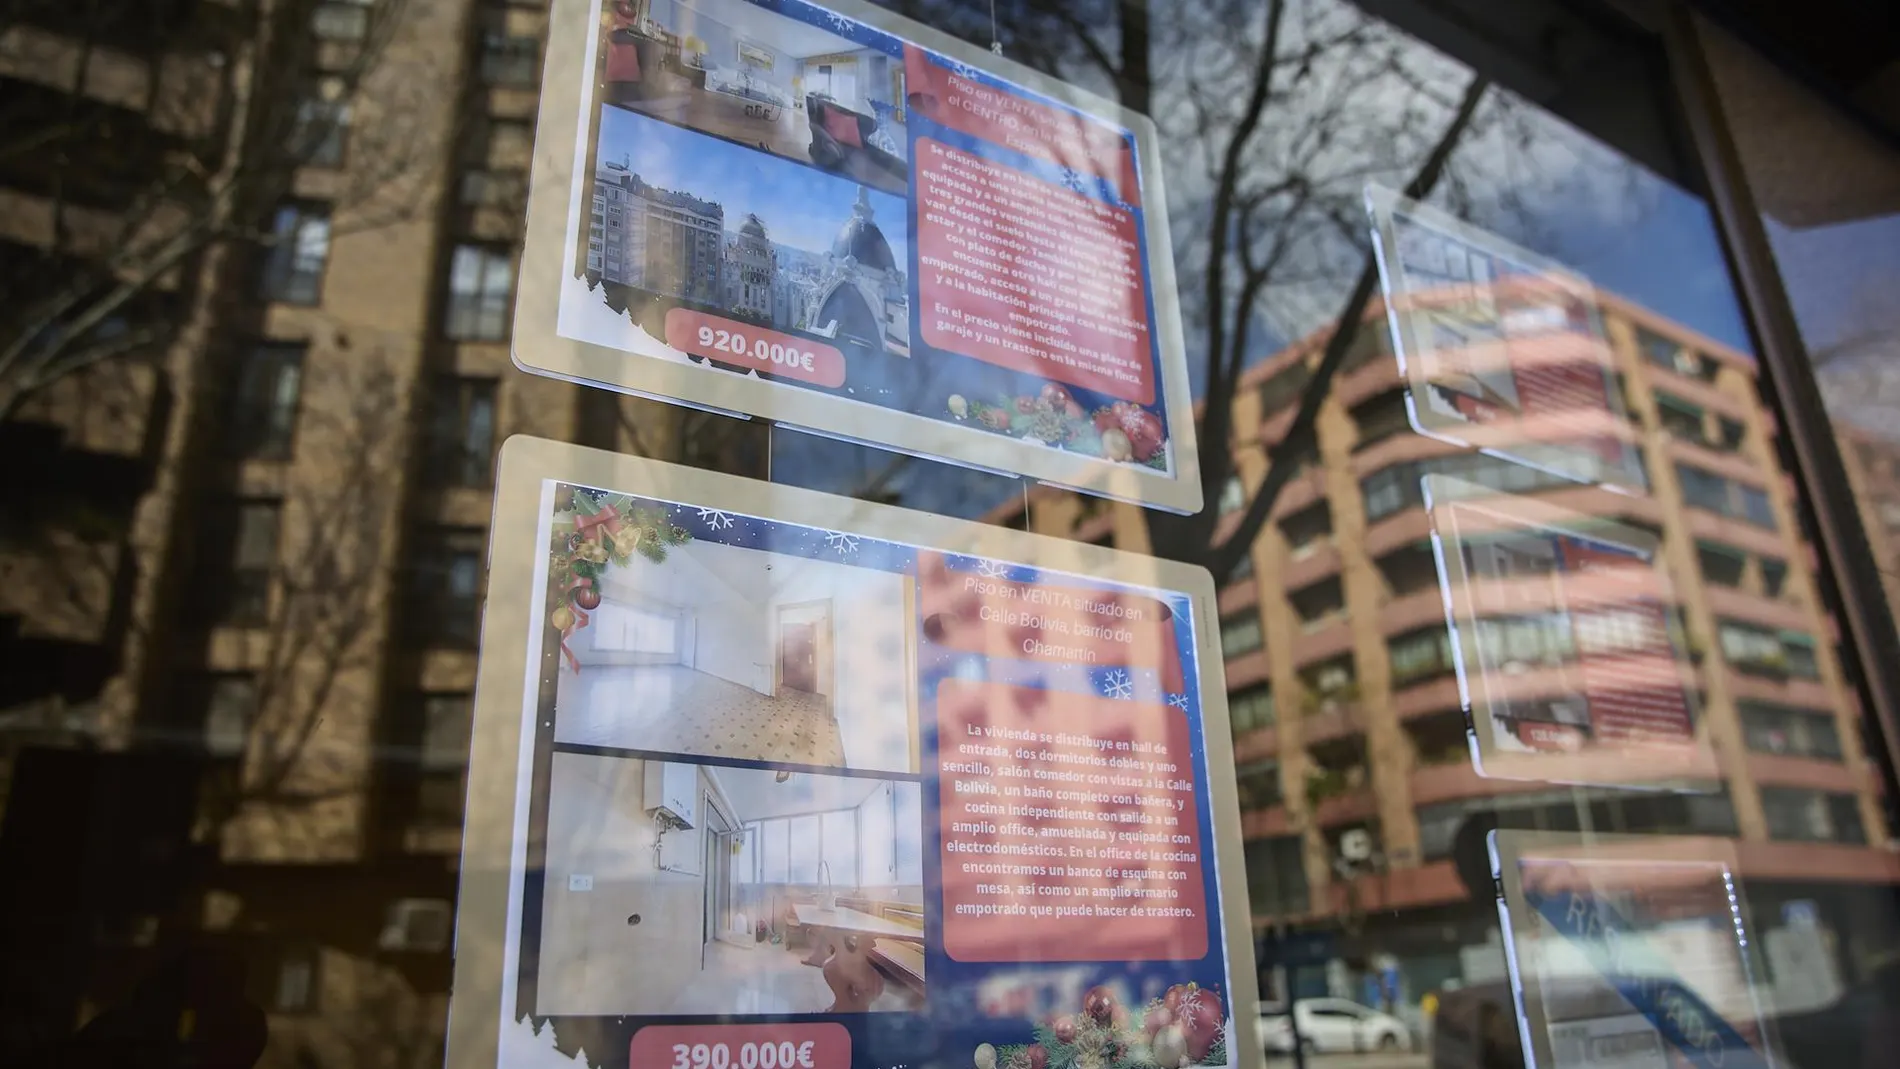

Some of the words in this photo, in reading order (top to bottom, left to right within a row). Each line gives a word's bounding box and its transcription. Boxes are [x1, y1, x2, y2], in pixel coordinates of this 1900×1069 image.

[931, 144, 944, 155] Se
[946, 149, 1001, 179] distribuye
[923, 168, 973, 195] equipada
[994, 195, 1009, 206] un
[929, 185, 953, 200] tres
[955, 194, 998, 217] grandes
[926, 198, 947, 212] van
[949, 205, 981, 223] desde
[983, 217, 993, 228] el
[927, 213, 956, 229] estar
[967, 226, 977, 236] el
[947, 234, 966, 246] con
[968, 240, 997, 259] plato
[999, 250, 1013, 262] de
[1015, 255, 1048, 273] ducha
[953, 251, 1009, 275] encuentra
[1012, 269, 1035, 282] otro
[922, 254, 988, 283] empotrado,
[991, 277, 1028, 294] acceso
[955, 279, 965, 290] la
[968, 283, 1027, 308] habitación
[1029, 302, 1075, 325] principal
[698, 327, 815, 372] 920.000€
[936, 302, 949, 314] En
[952, 308, 962, 318] el
[965, 312, 1000, 332] precio
[1003, 323, 1033, 339] viene
[1079, 347, 1100, 358] una
[1129, 360, 1142, 370] de
[937, 319, 973, 339] garaje
[985, 334, 1000, 344] un
[1003, 338, 1047, 358] trastero
[1050, 352, 1064, 362] en
[1066, 355, 1076, 366] la
[1078, 359, 1113, 376] misma
[965, 577, 997, 596] Piso
[1000, 586, 1017, 599] en
[1021, 587, 1072, 608] VENTA
[1074, 596, 1124, 617] situado
[1126, 607, 1143, 620] en
[980, 605, 1017, 625] Calle
[1021, 612, 1071, 635] Bolivia,
[1074, 621, 1114, 640] barrio
[1116, 628, 1134, 643] de
[1024, 637, 1097, 664] Chamartín
[969, 724, 981, 736] La
[986, 726, 1037, 741] vivienda
[1041, 733, 1053, 743] se
[1056, 733, 1113, 752] distribuye
[1116, 741, 1129, 750] en
[1132, 741, 1152, 753] hall
[1155, 744, 1167, 755] de
[960, 742, 1013, 760] entrada,
[1016, 747, 1037, 760] dos
[1040, 749, 1108, 766] dormitorios
[1110, 756, 1145, 769] dobles
[1148, 761, 1154, 773] y
[1157, 762, 1177, 772] uno
[943, 759, 994, 777] sencillo,
[998, 763, 1031, 778] salón
[1035, 767, 1084, 782] comedor
[1088, 773, 1107, 784] con
[1111, 773, 1144, 787] vistas
[1146, 778, 1152, 788] a
[1155, 776, 1164, 789] la
[1167, 778, 1192, 791] Calle
[955, 780, 1002, 796] Bolivia,
[1005, 786, 1020, 796] un
[1024, 785, 1053, 799] baño
[1057, 788, 1110, 806] completo
[1113, 793, 1131, 804] con
[1135, 793, 1175, 809] bañera,
[1178, 799, 1184, 811] y
[965, 800, 1005, 814] cocina
[1009, 803, 1095, 823] independiente
[1098, 811, 1117, 821] con
[1121, 811, 1153, 824] salida
[1156, 816, 1162, 824] a
[1165, 816, 1178, 825] un
[953, 819, 996, 837] amplio
[1001, 822, 1038, 837] office,
[1041, 824, 1106, 839] amueblada
[1109, 830, 1116, 843] y
[1119, 829, 1169, 845] equipada
[1172, 834, 1191, 844] con
[947, 839, 1067, 857] electrodomésticos.
[1070, 846, 1083, 857] En
[1087, 846, 1096, 858] el
[1100, 846, 1132, 859] office
[1135, 848, 1148, 860] de
[1151, 849, 1161, 860] la
[1163, 849, 1197, 862] cocina
[963, 861, 1046, 875] encontramos
[1050, 866, 1064, 875] un
[1068, 865, 1102, 877] banco
[1106, 866, 1119, 877] de
[1122, 867, 1165, 882] esquina
[1168, 870, 1187, 880] con
[977, 883, 1014, 897] mesa,
[1017, 882, 1036, 895] así
[1039, 885, 1071, 896] como
[1074, 887, 1089, 896] un
[1092, 885, 1131, 900] amplio
[1134, 886, 1178, 898] armario
[956, 901, 1026, 919] empotrado
[1030, 905, 1052, 919] que
[1056, 904, 1092, 919] puede
[1096, 904, 1130, 916] hacer
[1131, 904, 1145, 916] de
[1147, 906, 1195, 917] trastero.
[672, 1041, 814, 1069] 390.000€
